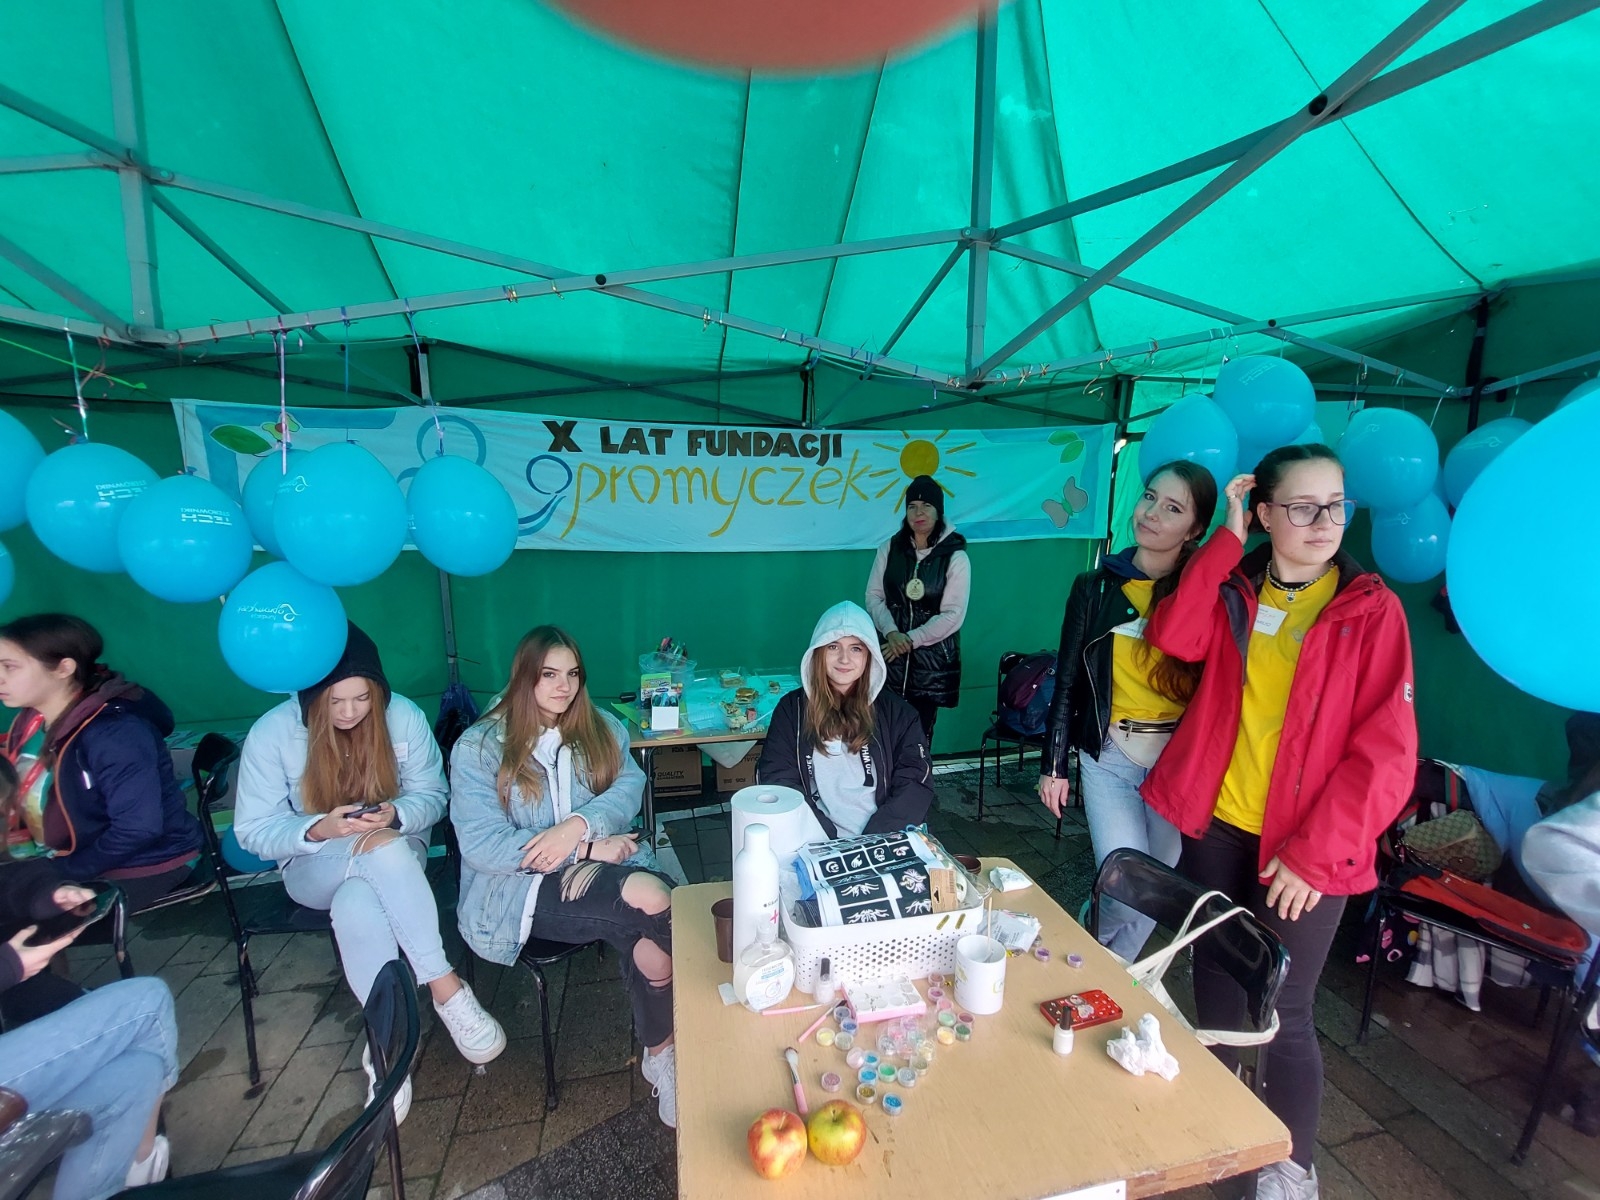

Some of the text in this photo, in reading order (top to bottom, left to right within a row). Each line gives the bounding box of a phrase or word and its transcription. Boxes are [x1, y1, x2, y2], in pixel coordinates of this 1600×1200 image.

[541, 420, 843, 467] X LAT FUNDACJI
[181, 513, 233, 526] TECH
